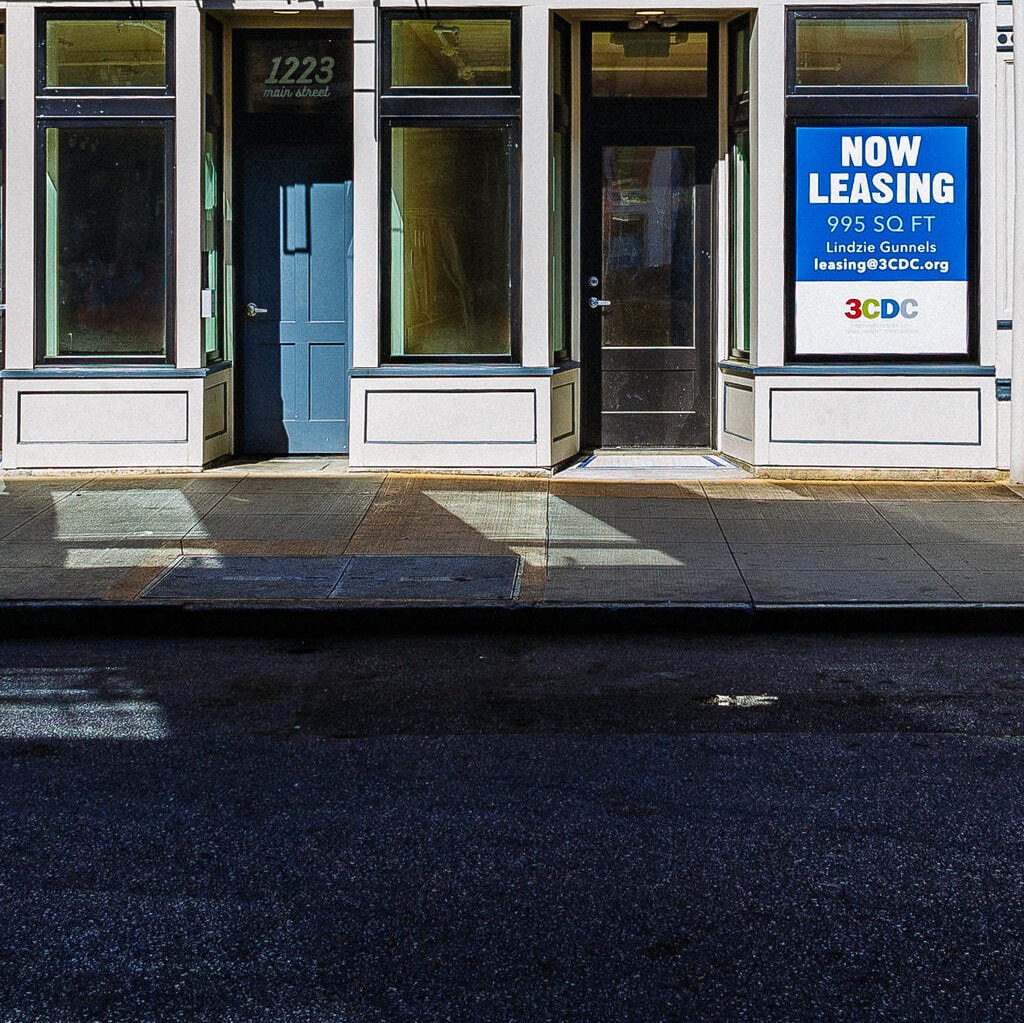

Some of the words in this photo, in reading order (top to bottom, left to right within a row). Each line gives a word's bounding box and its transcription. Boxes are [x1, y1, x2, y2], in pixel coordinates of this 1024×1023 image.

[264, 56, 335, 84] 1223
[263, 85, 293, 97] main
[295, 85, 331, 97] street
[841, 135, 922, 167] NOW
[808, 172, 955, 204] LEASING
[827, 216, 865, 233] 995
[873, 216, 904, 233] SQ
[911, 216, 936, 233] FT
[826, 241, 876, 253] Lindzie
[879, 241, 937, 253] Gunnels
[814, 258, 949, 274] leasing@3CDC.org
[844, 298, 919, 319] 3CDC
